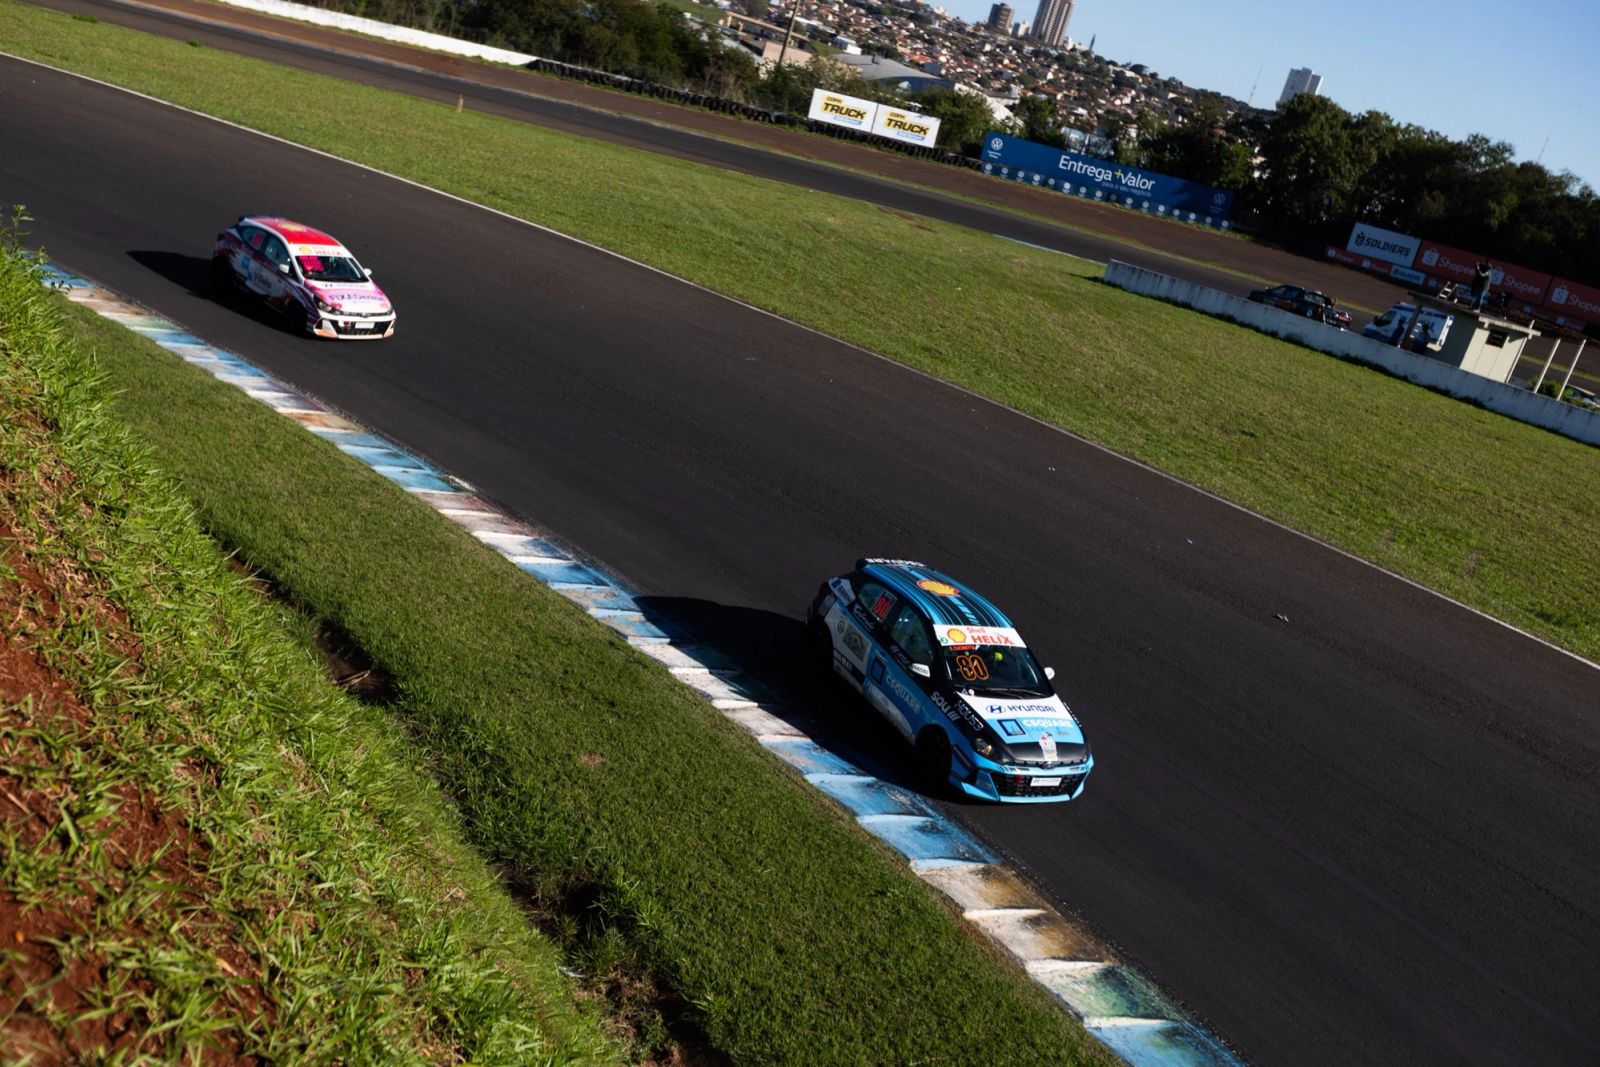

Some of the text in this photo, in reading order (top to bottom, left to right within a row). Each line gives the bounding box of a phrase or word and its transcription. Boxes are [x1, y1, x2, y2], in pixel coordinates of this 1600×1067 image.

[824, 102, 867, 120] TRUCK
[886, 117, 930, 135] TRUCK
[1058, 155, 1112, 182] Entrega
[1364, 238, 1412, 257] SOLDIERS
[1503, 275, 1541, 296] Shopee
[971, 634, 1014, 646] HELIX
[885, 674, 921, 715] CSQUARE
[1006, 703, 1057, 713] HYUNDAI
